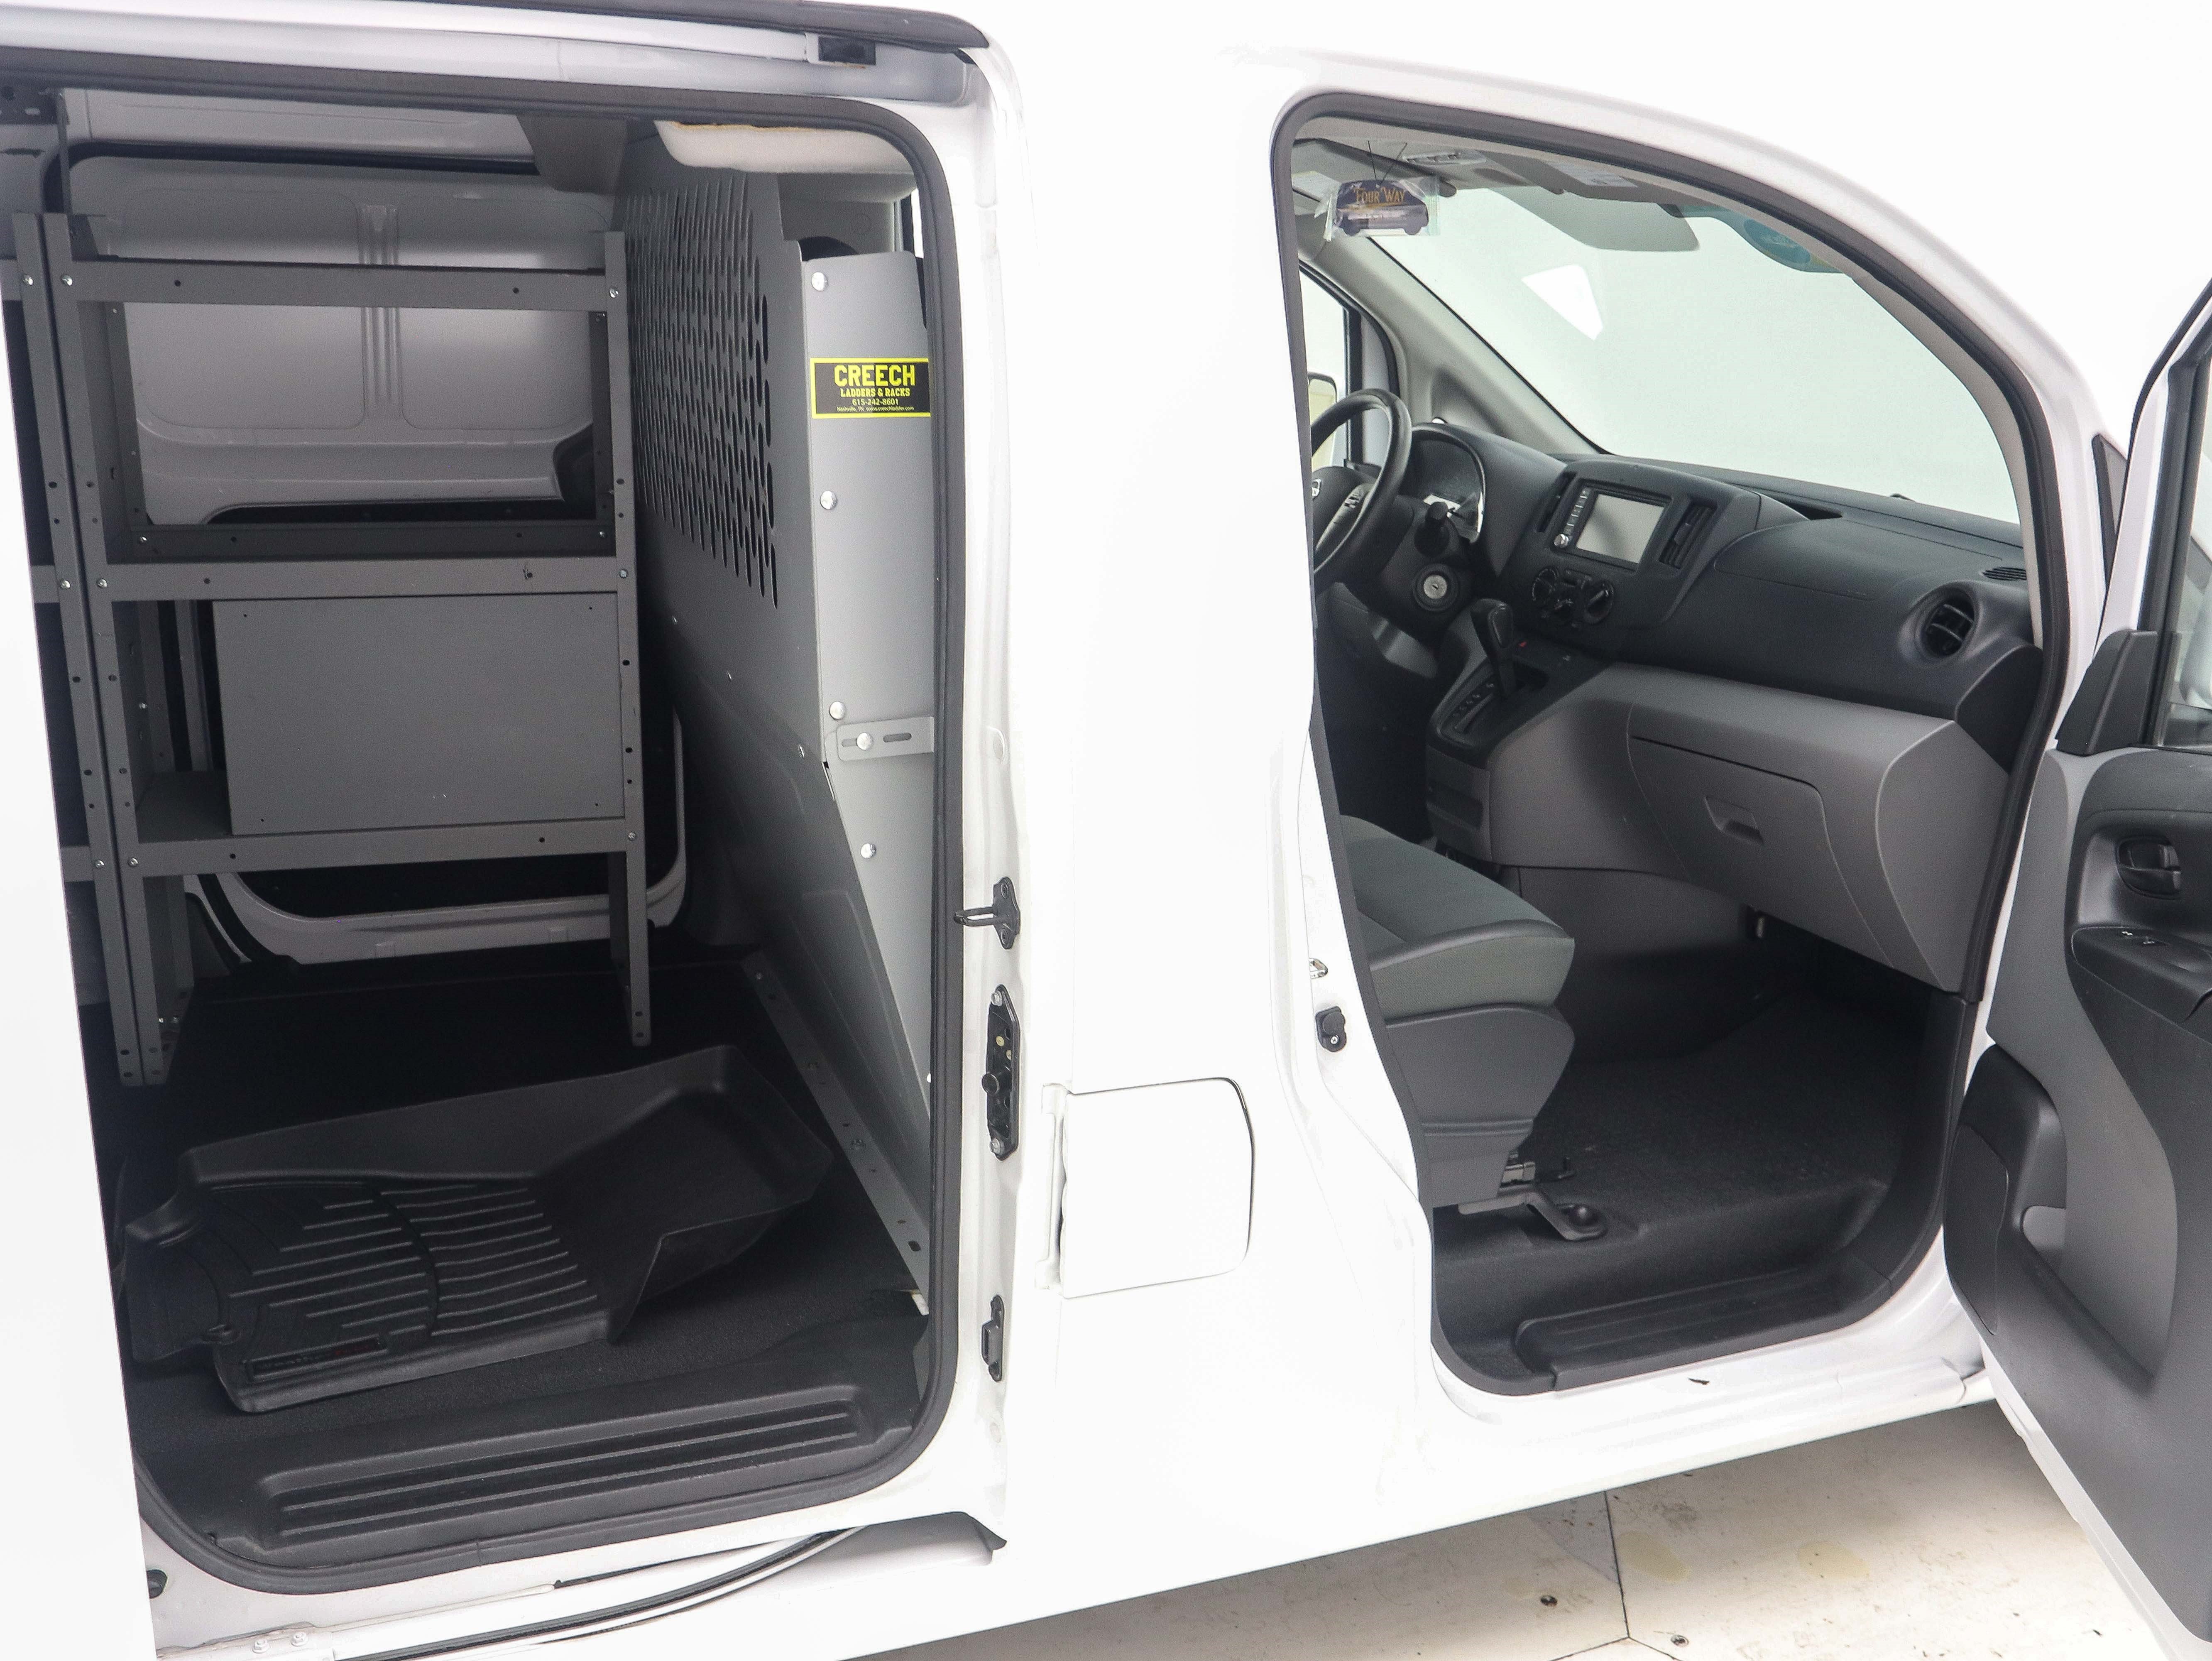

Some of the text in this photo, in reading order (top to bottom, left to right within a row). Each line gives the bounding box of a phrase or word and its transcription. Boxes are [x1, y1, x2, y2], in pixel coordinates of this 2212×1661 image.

[834, 364, 916, 387] CREECH
[839, 387, 910, 397] LADDERS & RACKS
[852, 398, 899, 406] 615-242-8601
